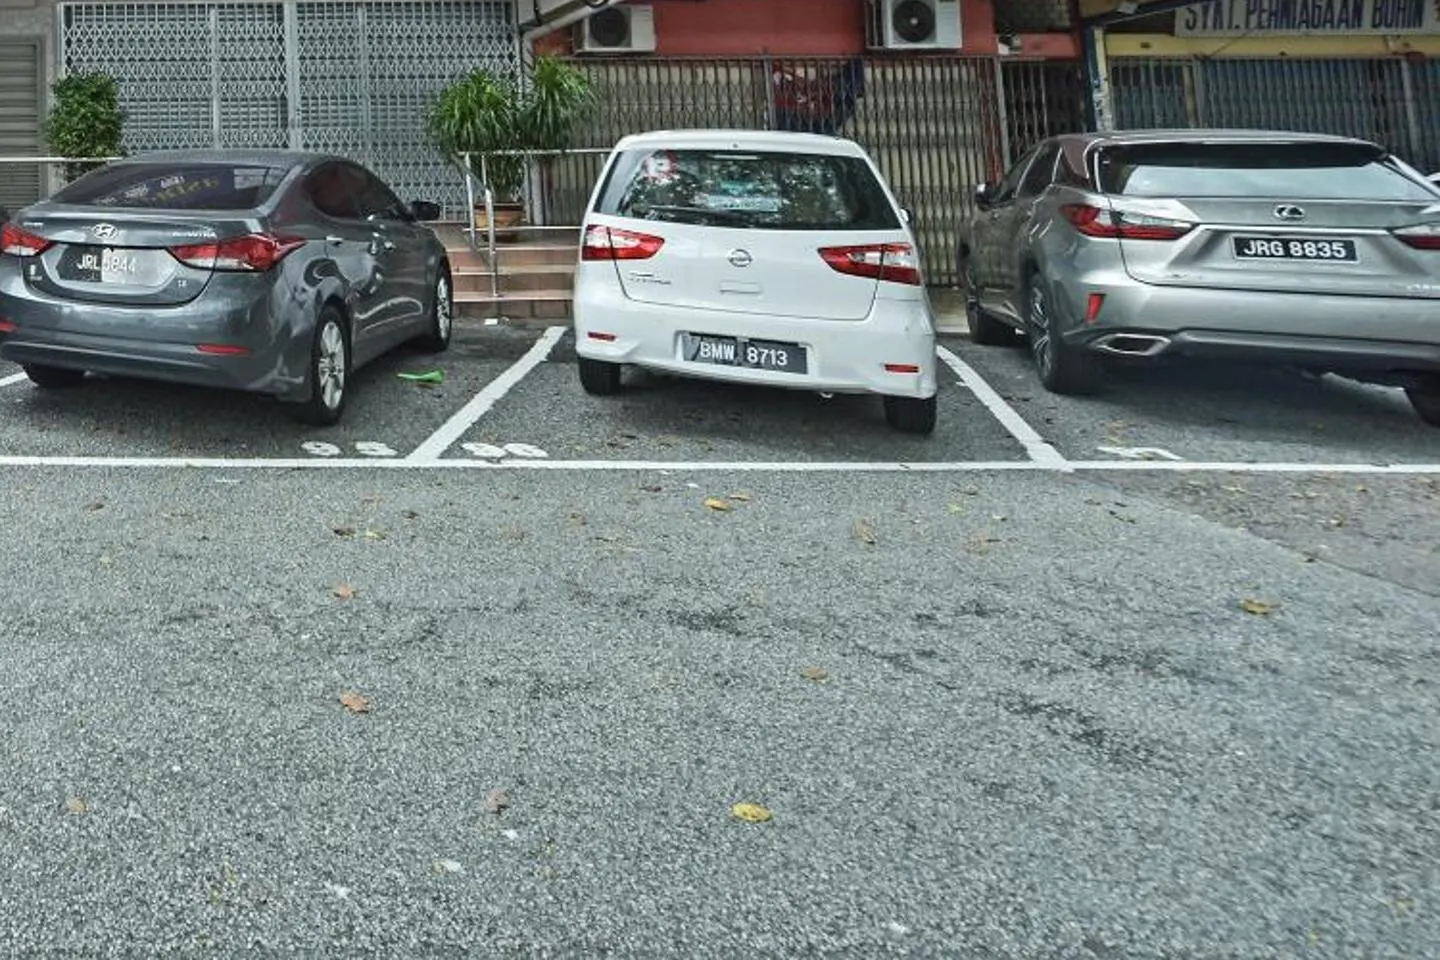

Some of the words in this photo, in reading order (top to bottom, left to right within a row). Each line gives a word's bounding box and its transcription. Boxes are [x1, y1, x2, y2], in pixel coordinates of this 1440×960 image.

[1243, 239, 1285, 256] JRG
[1288, 241, 1347, 258] 8835
[700, 341, 735, 360] BMW
[746, 346, 788, 366] 8713
